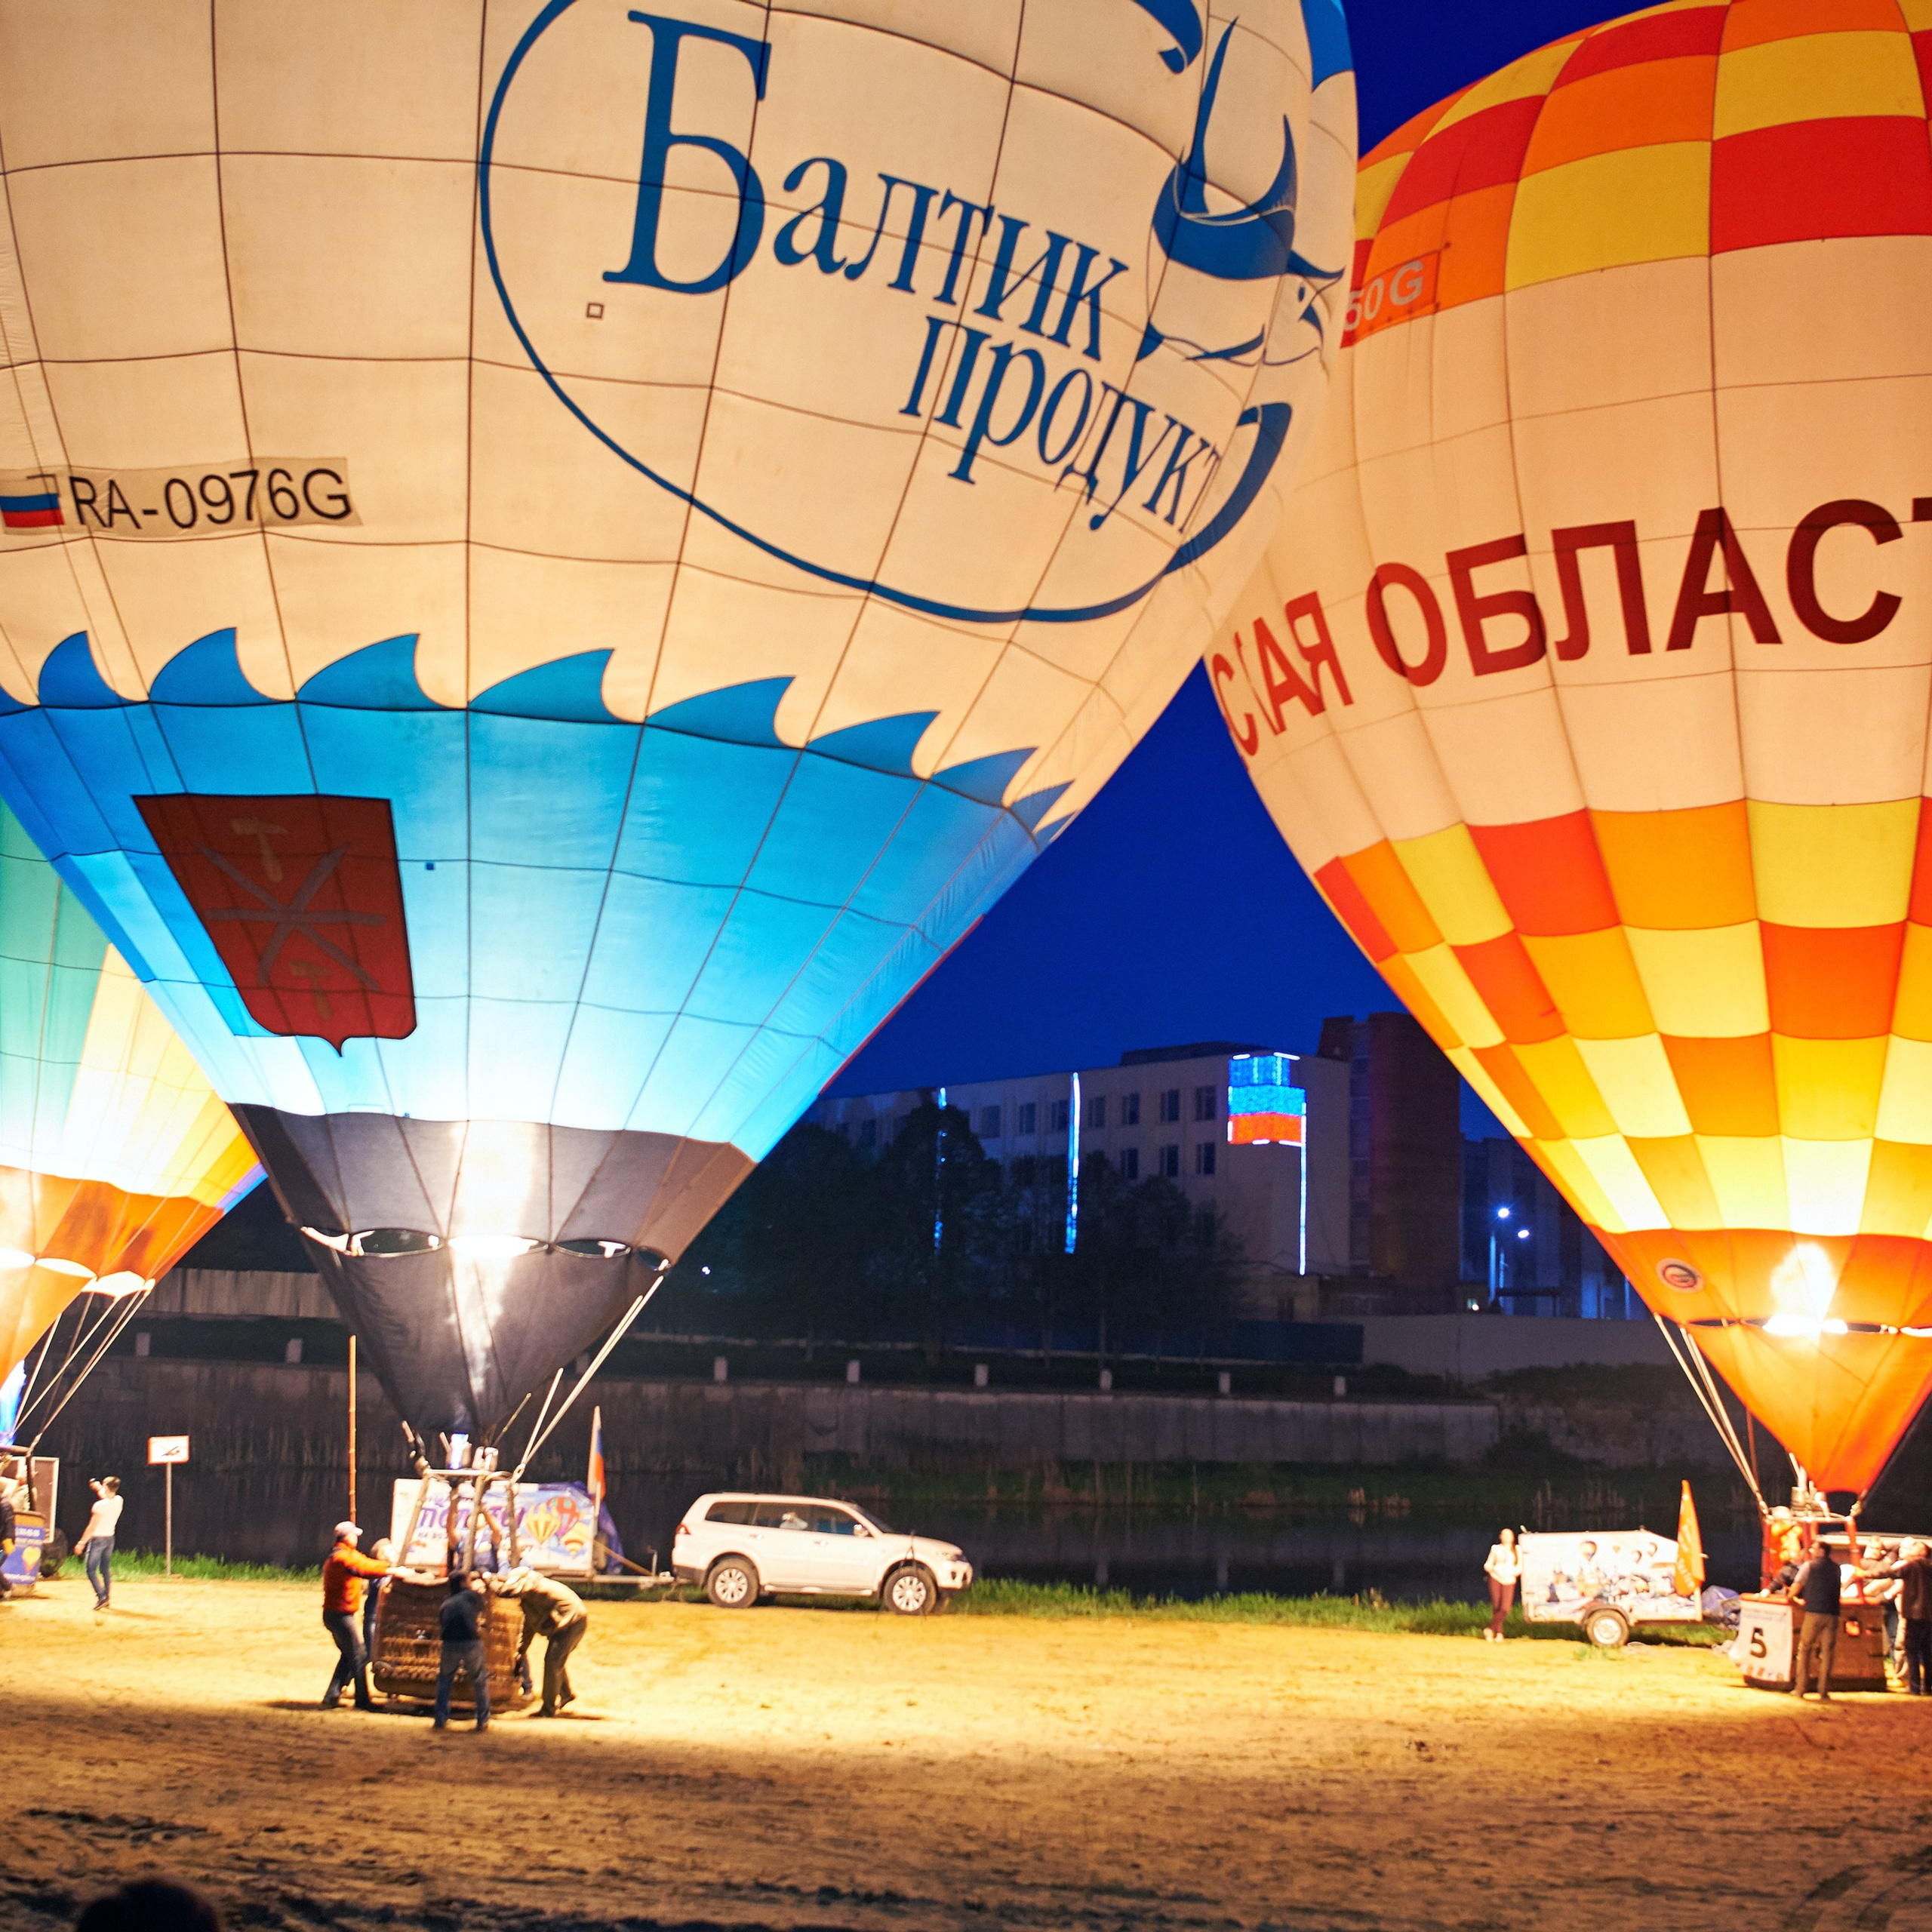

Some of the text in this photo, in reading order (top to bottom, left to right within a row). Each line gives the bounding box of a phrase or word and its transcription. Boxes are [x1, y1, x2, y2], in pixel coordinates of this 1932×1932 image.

[603, 10, 1128, 361] Балтик
[69, 469, 352, 530] RA-0976G
[1366, 496, 1932, 688] ОБЛАС
[1749, 1627, 1767, 1659] 5
